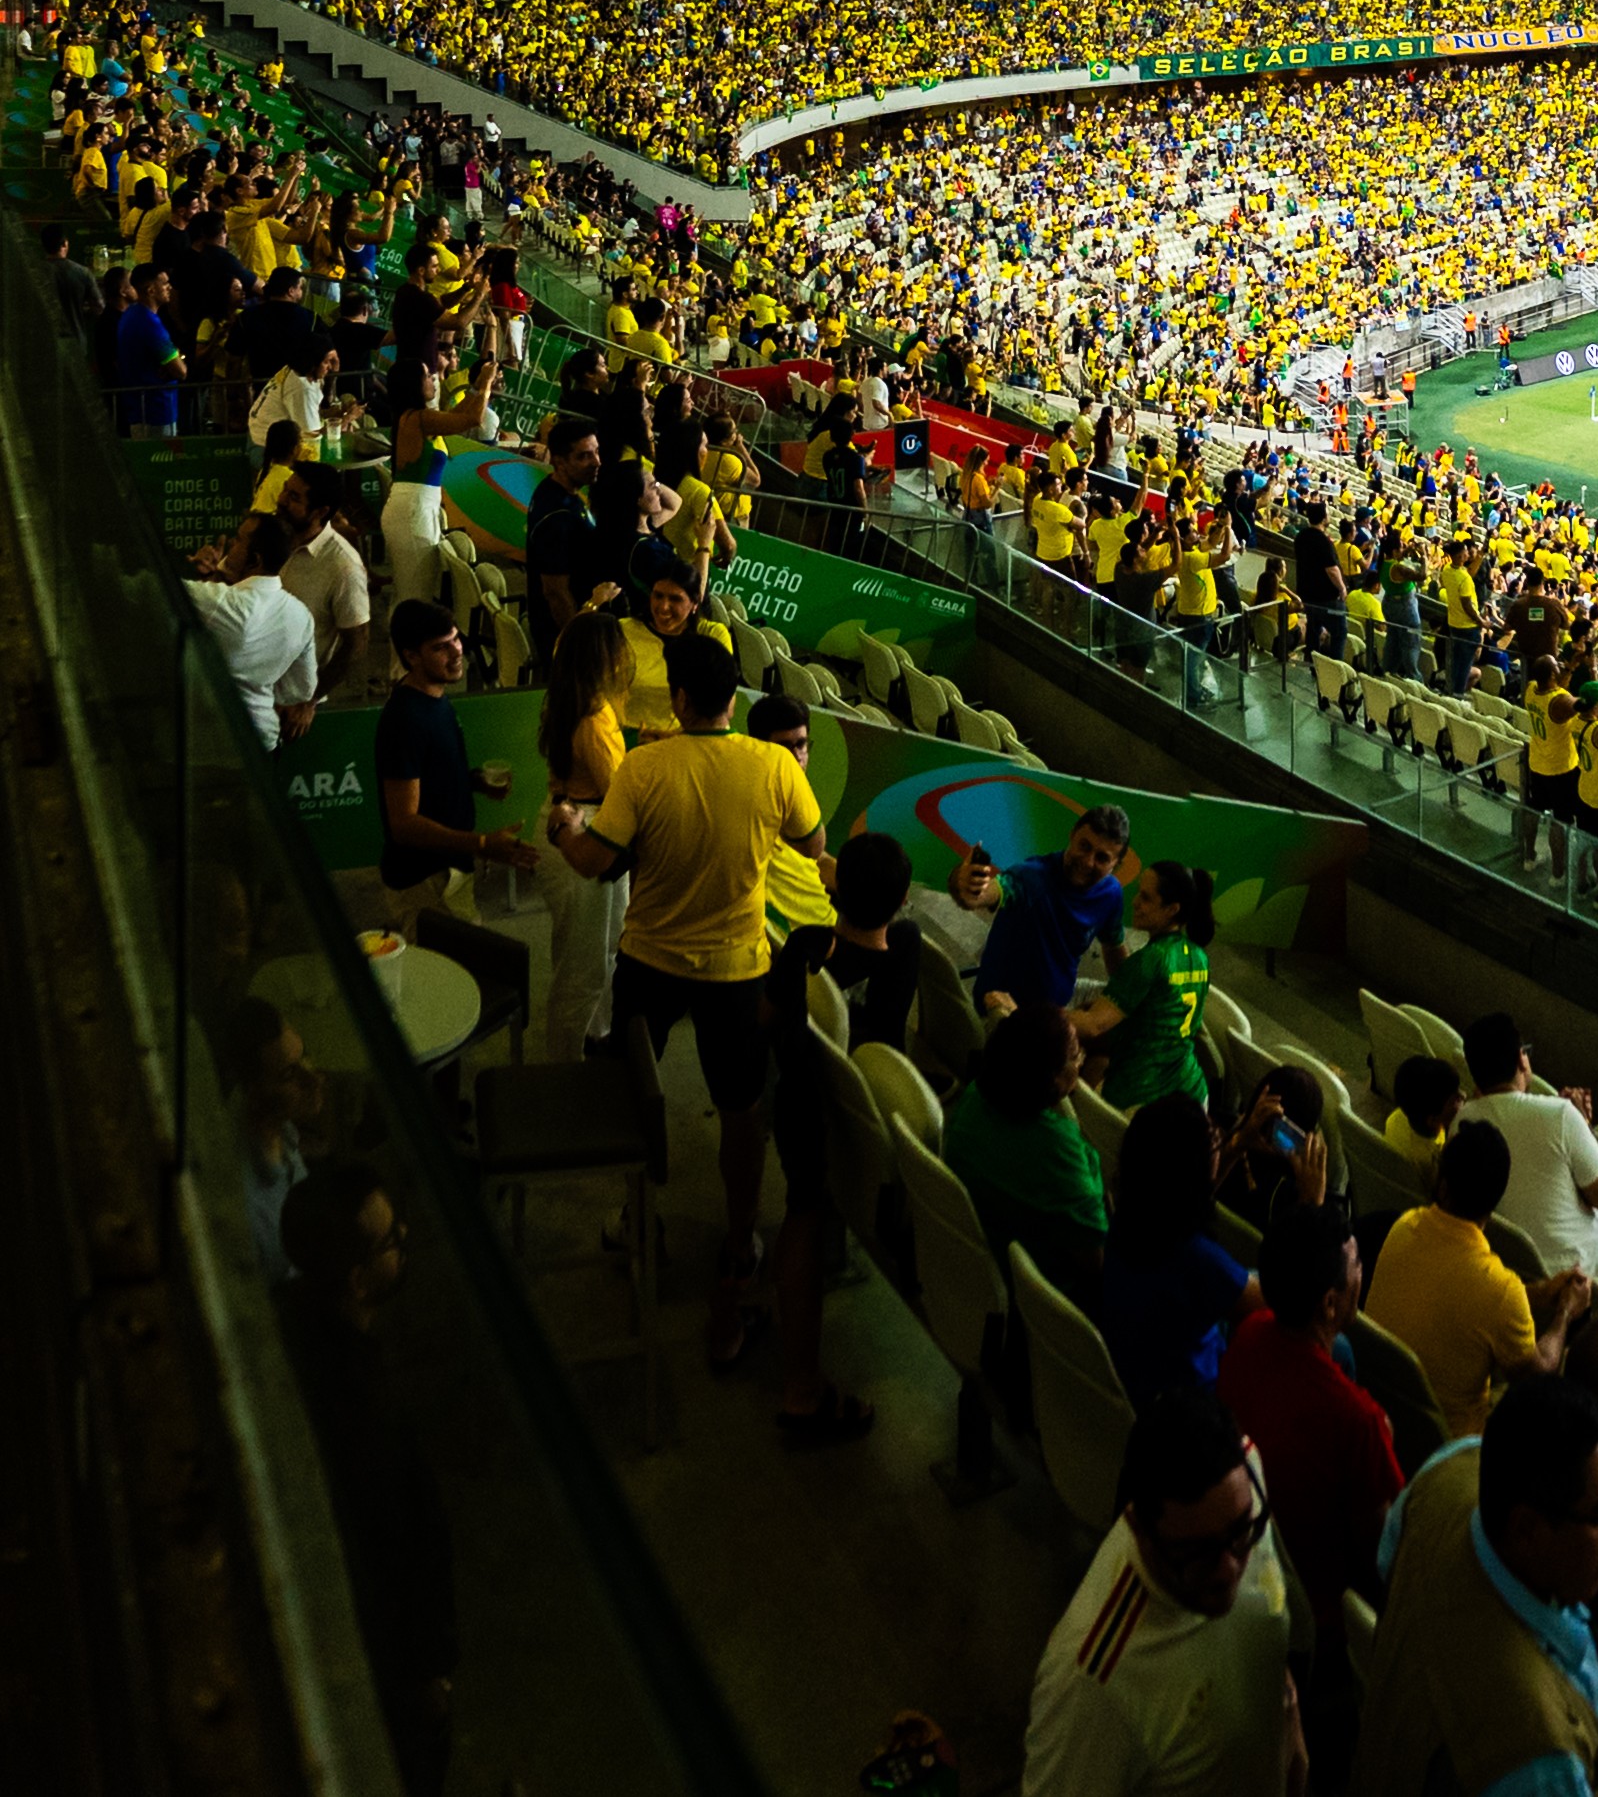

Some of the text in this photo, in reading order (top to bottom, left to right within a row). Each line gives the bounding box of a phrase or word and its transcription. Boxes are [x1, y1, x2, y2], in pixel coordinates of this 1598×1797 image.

[1155, 45, 1308, 75] SELEÇÃO
[165, 477, 220, 495] ONDE O
[165, 496, 233, 514] CORAÇÃO
[165, 517, 204, 532] BATE
[748, 591, 799, 624] ALTO
[1179, 991, 1197, 1039] 7
